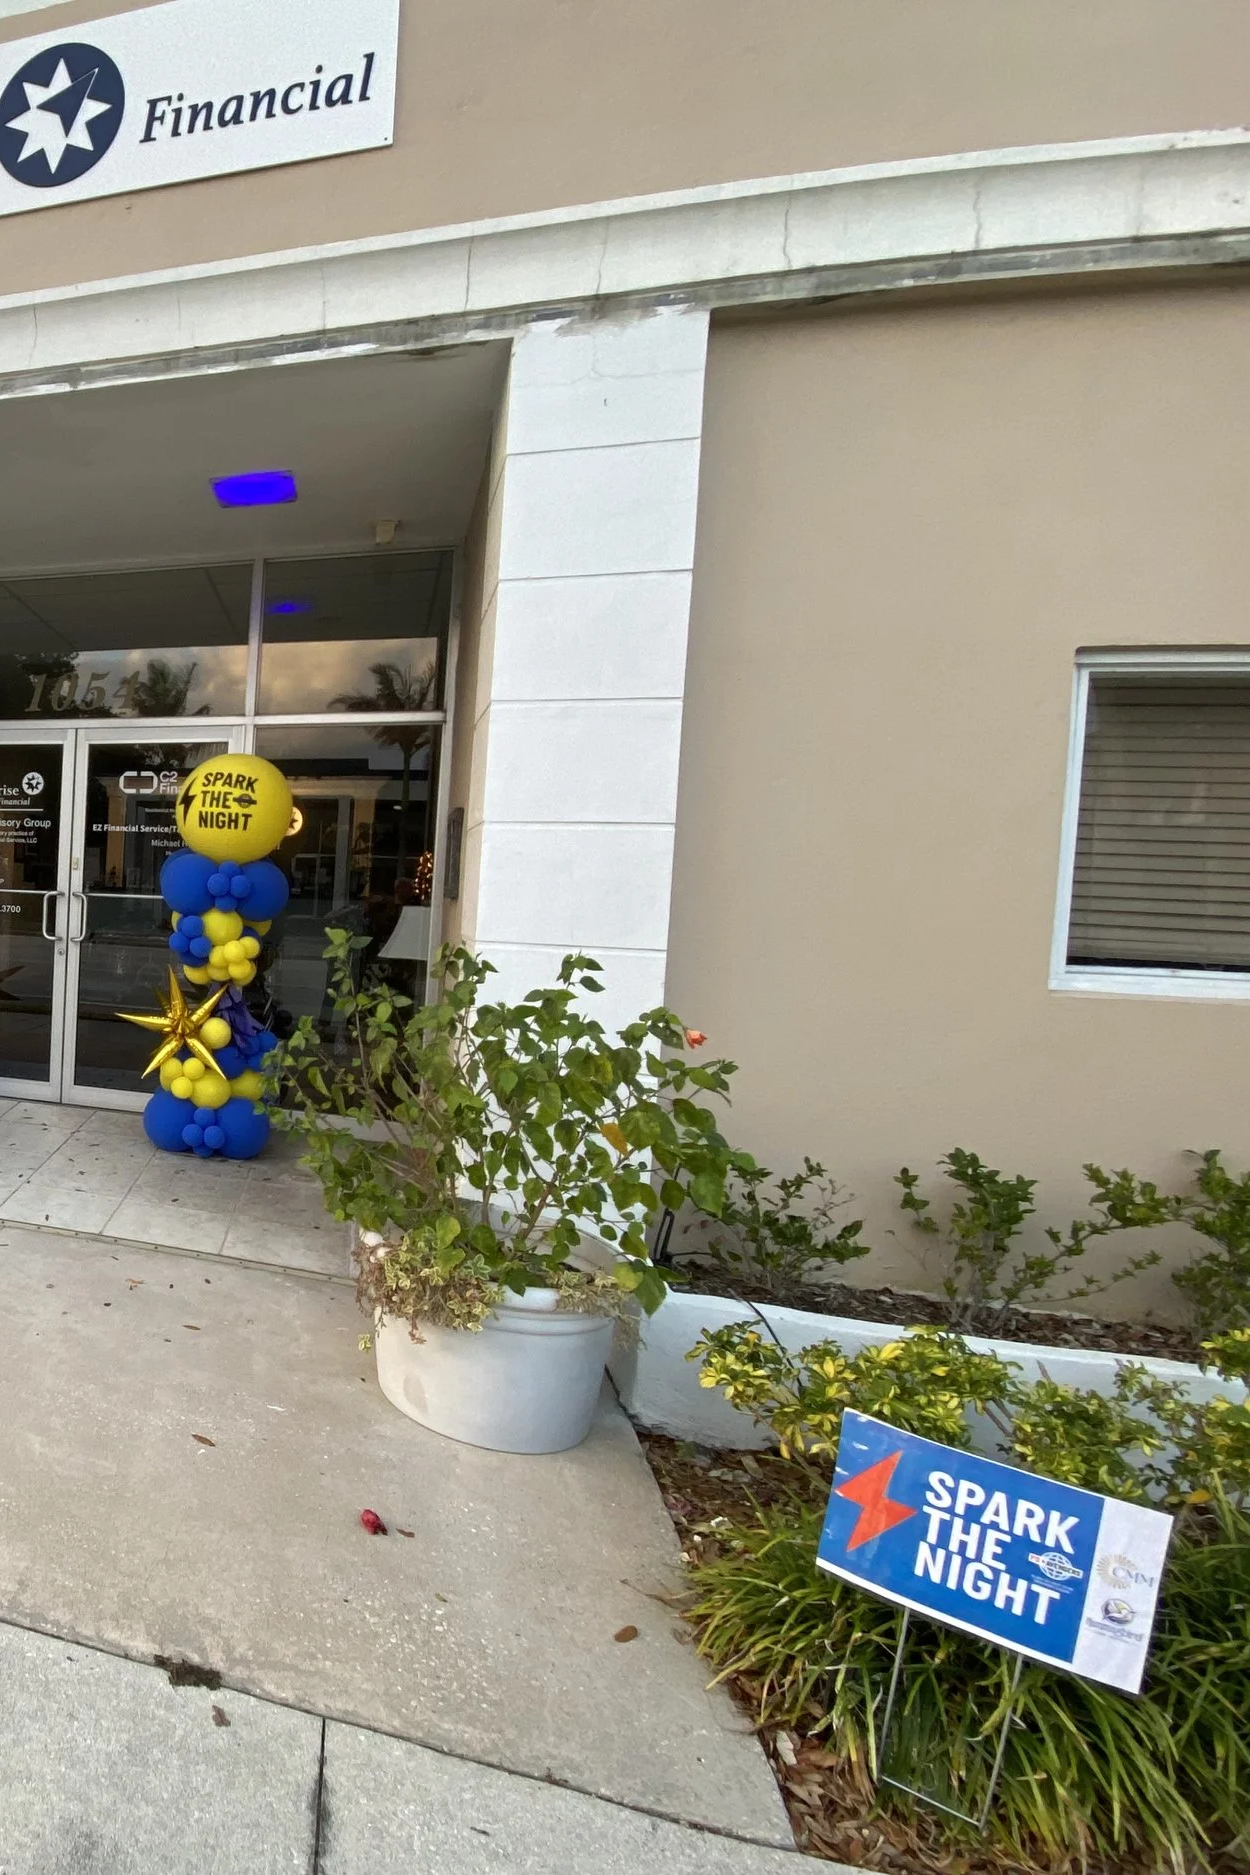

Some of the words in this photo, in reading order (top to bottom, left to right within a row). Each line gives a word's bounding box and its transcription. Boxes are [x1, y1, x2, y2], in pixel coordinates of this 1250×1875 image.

[139, 51, 375, 143] Financial
[24, 670, 140, 712] 1054
[159, 771, 178, 782] C2
[202, 771, 258, 793] SPARK
[201, 790, 233, 809] THE
[23, 818, 51, 829] Group
[92, 823, 102, 832] EZ
[103, 823, 138, 832] Financial
[198, 810, 252, 832] NIGHT
[151, 839, 180, 847] Michael
[925, 1470, 1080, 1556] SPARK
[922, 1504, 1012, 1571] THE
[914, 1540, 1061, 1626] NIGHT
